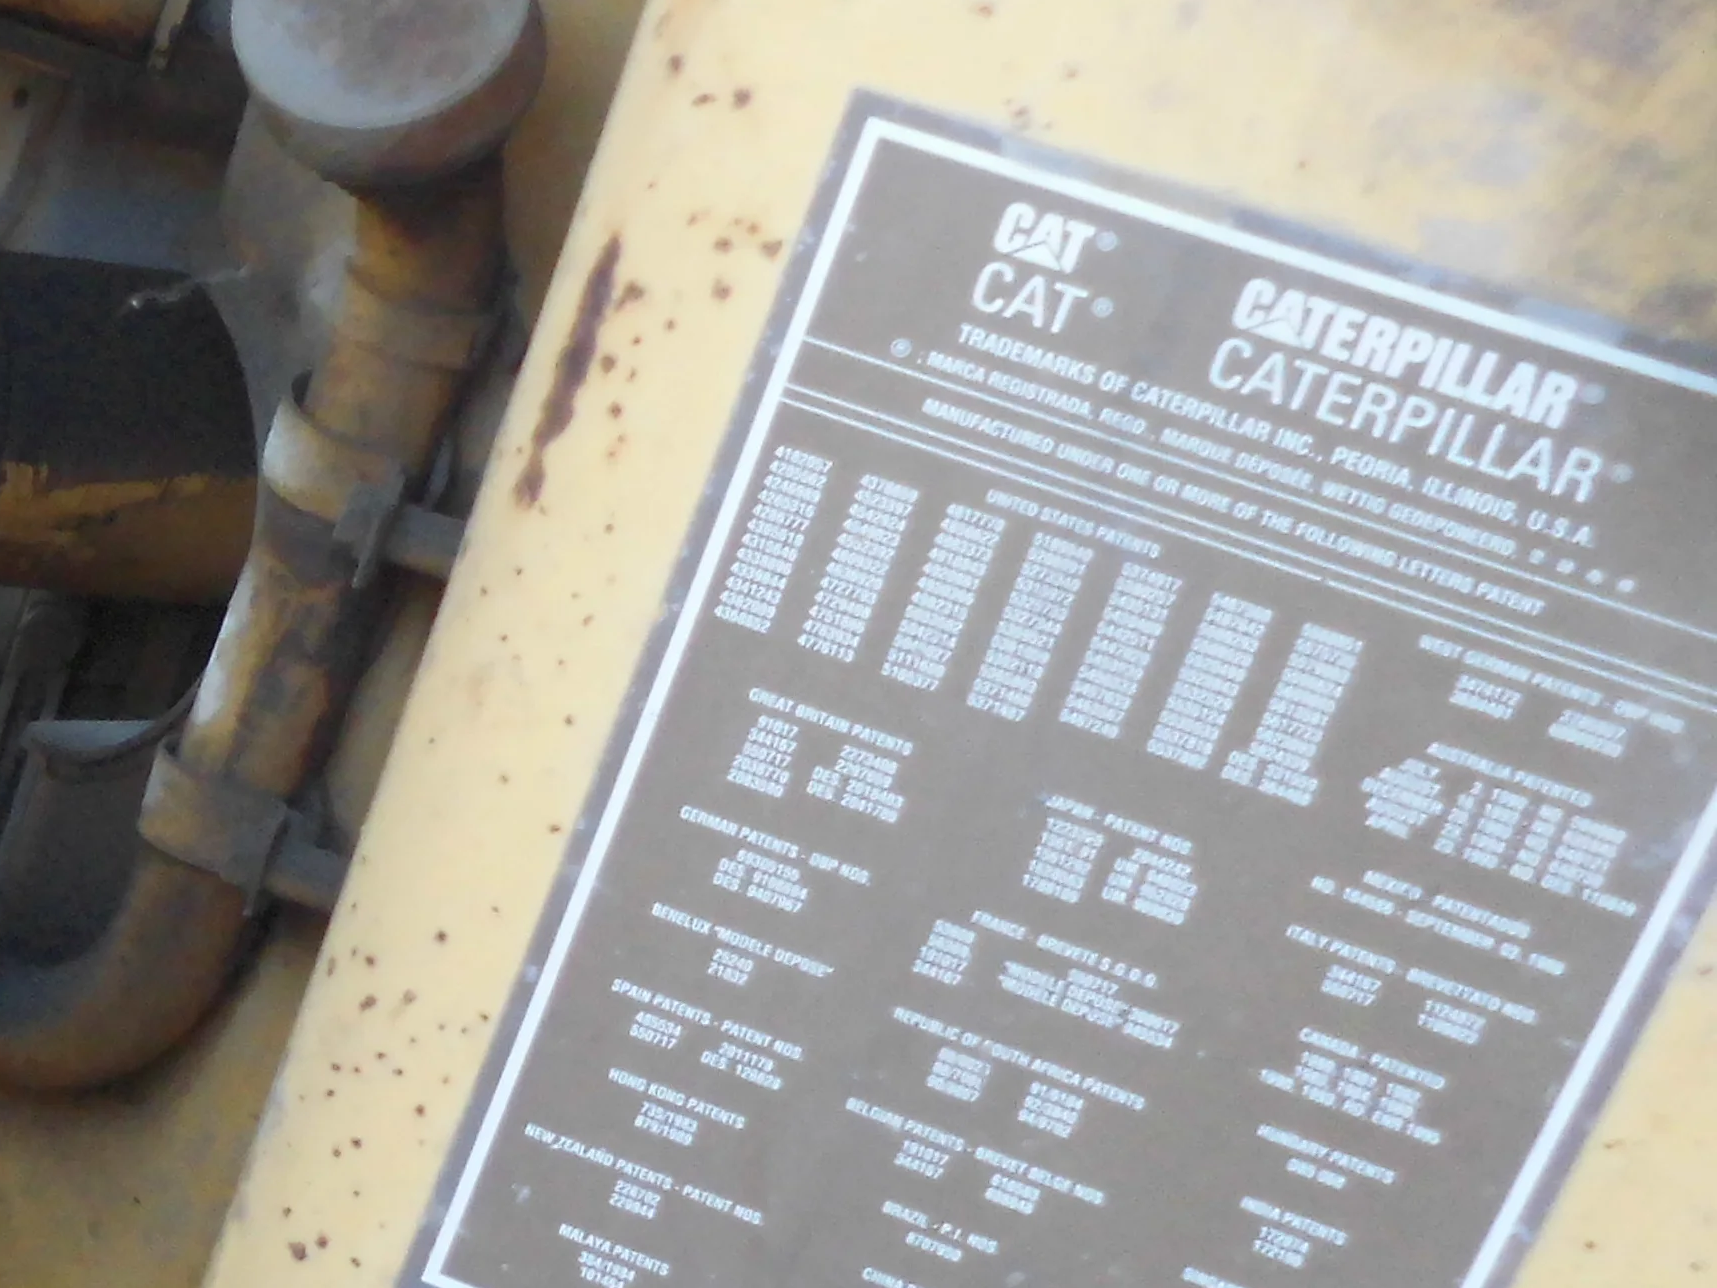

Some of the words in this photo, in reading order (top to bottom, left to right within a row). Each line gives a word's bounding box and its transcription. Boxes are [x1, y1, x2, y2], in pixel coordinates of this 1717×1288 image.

[994, 203, 1094, 271] CAT
[972, 262, 1088, 332] CAT
[1234, 280, 1576, 426] CATERPILLAR
[926, 351, 984, 381] MARCA
[1160, 428, 1232, 462] MARQUE
[959, 323, 1095, 383] TRADEMARKS
[1099, 370, 1128, 392] OF
[1131, 381, 1270, 440] CATERPILLAR
[1330, 446, 1412, 489] PEORIA,
[1422, 476, 1516, 523] ILLINOIS,
[1527, 510, 1591, 546] U.S.A.
[1210, 339, 1601, 500] CATERPILLAR
[922, 398, 1053, 452] MANUFACTURED
[1056, 443, 1114, 472] UNDER
[1116, 462, 1150, 484] ONE
[1153, 475, 1179, 494] OR
[1180, 484, 1231, 512] MORE
[1232, 501, 1257, 519] OF
[1260, 509, 1293, 532] THE
[1295, 522, 1396, 566] FOLLOWING
[1397, 557, 1473, 592] LETTERS
[1476, 582, 1544, 614] PATENT
[986, 489, 1038, 516] UNITED
[1040, 507, 1093, 535] STATES
[1096, 526, 1160, 557] PATENTS
[748, 687, 794, 711] GREAT
[795, 704, 850, 732] BRITAIN
[851, 724, 912, 755] PATENTS
[1531, 673, 1601, 705] PATENTS
[1426, 742, 1510, 778] AUSTRALIA
[679, 805, 738, 835] GERMAN
[738, 826, 798, 857] PATENTS
[838, 863, 869, 885] NOS.
[1045, 795, 1094, 819] JAPAN
[1104, 813, 1158, 841] PATENT
[712, 871, 740, 891] DES.
[1363, 870, 1421, 899] MEXICO
[651, 902, 711, 934] BENELUX
[971, 910, 1025, 939] FRANCE
[1285, 924, 1329, 948] ITALY
[1329, 940, 1395, 973] PATENTS
[611, 978, 651, 1002] SPAIN
[652, 994, 710, 1024] PATENTS
[720, 1020, 771, 1046] PATENT
[1299, 1027, 1358, 1057] CANADA
[893, 1006, 959, 1040] REPUBLIC
[961, 1032, 981, 1046] OF
[1030, 1058, 1080, 1085] AFRICA
[1082, 1077, 1145, 1110] PATENTS
[608, 1067, 646, 1091] HONG
[647, 1083, 685, 1105] KONG
[686, 1097, 745, 1128] PATENTS
[524, 1123, 556, 1147] NEW
[553, 1136, 613, 1166] ZEALAND
[615, 1158, 672, 1189] PATENTS
[682, 1184, 732, 1211] PATENT
[733, 1204, 763, 1225] NOS.
[845, 1097, 903, 1129] BELGIAN
[904, 1119, 964, 1151] PATENTS
[974, 1146, 1027, 1173] BREVET
[1027, 1167, 1072, 1192] BELGE
[1256, 1124, 1328, 1157] HUNGARY
[1328, 1151, 1395, 1184] PATENTS
[881, 1200, 927, 1228] BRAZIL
[1239, 1196, 1280, 1219] INDIA
[1281, 1212, 1347, 1245] PATENTS
[558, 1223, 610, 1252] MALAYA
[612, 1245, 669, 1275] PATENTS
